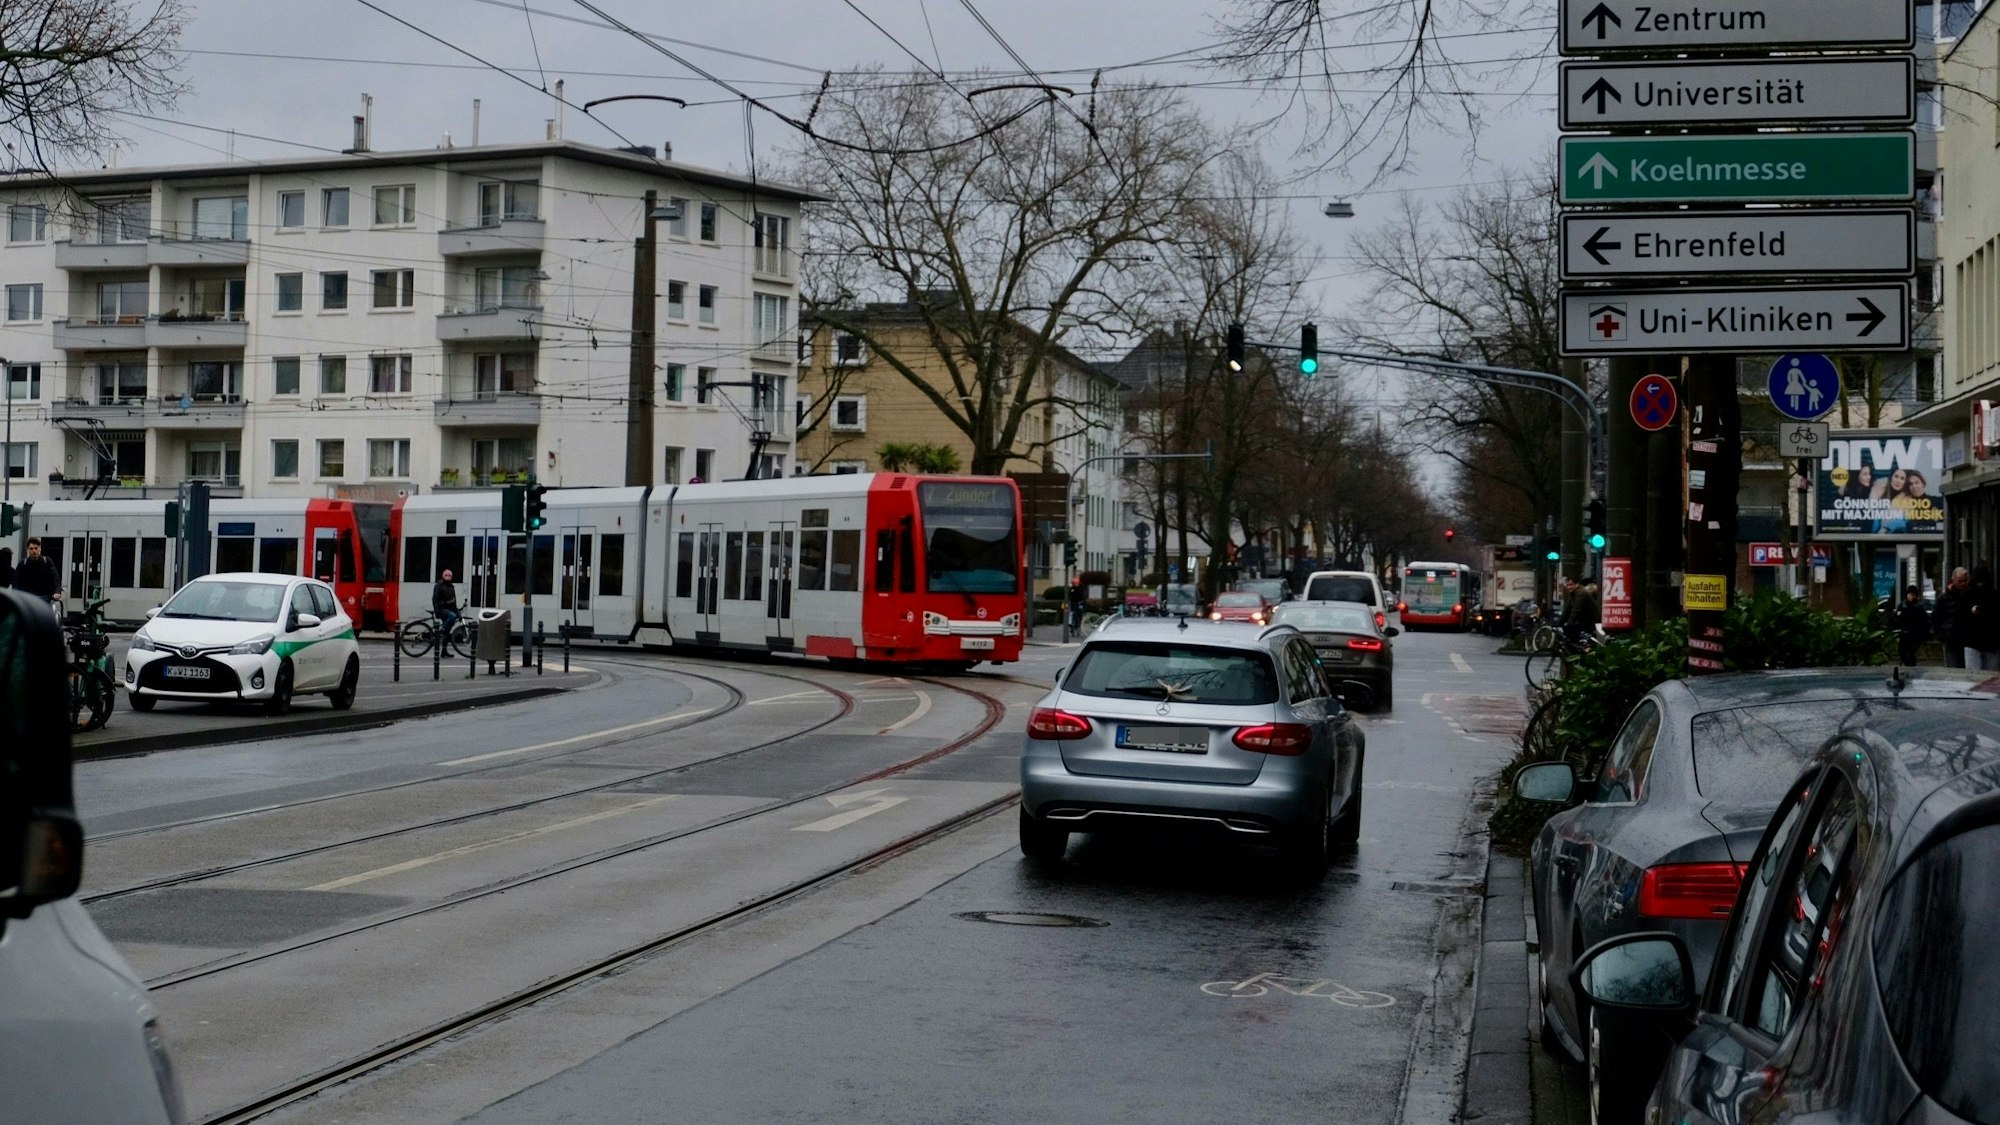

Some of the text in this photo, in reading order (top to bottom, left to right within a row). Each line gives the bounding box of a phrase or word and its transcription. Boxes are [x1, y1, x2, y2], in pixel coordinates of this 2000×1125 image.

[1634, 7, 1766, 32] Zentrum
[1634, 78, 1805, 107] Universität
[1630, 156, 1807, 182] Koelnmesse
[1634, 231, 1785, 258] Ehrenfeld
[1639, 306, 1833, 334] Uni-Kliniken
[1796, 445, 1812, 454] frei
[947, 488, 996, 503] Zündorf
[1834, 496, 1931, 509] GÖNN DIR RADIO
[1821, 509, 1944, 520] MIT MAXIMUM MUSIK
[1603, 566, 1624, 579] TAG
[1602, 579, 1626, 601] 24
[1688, 581, 1721, 591] Ausfahrt
[1609, 615, 1630, 624] KÖLN
[190, 669, 210, 678] 1163
